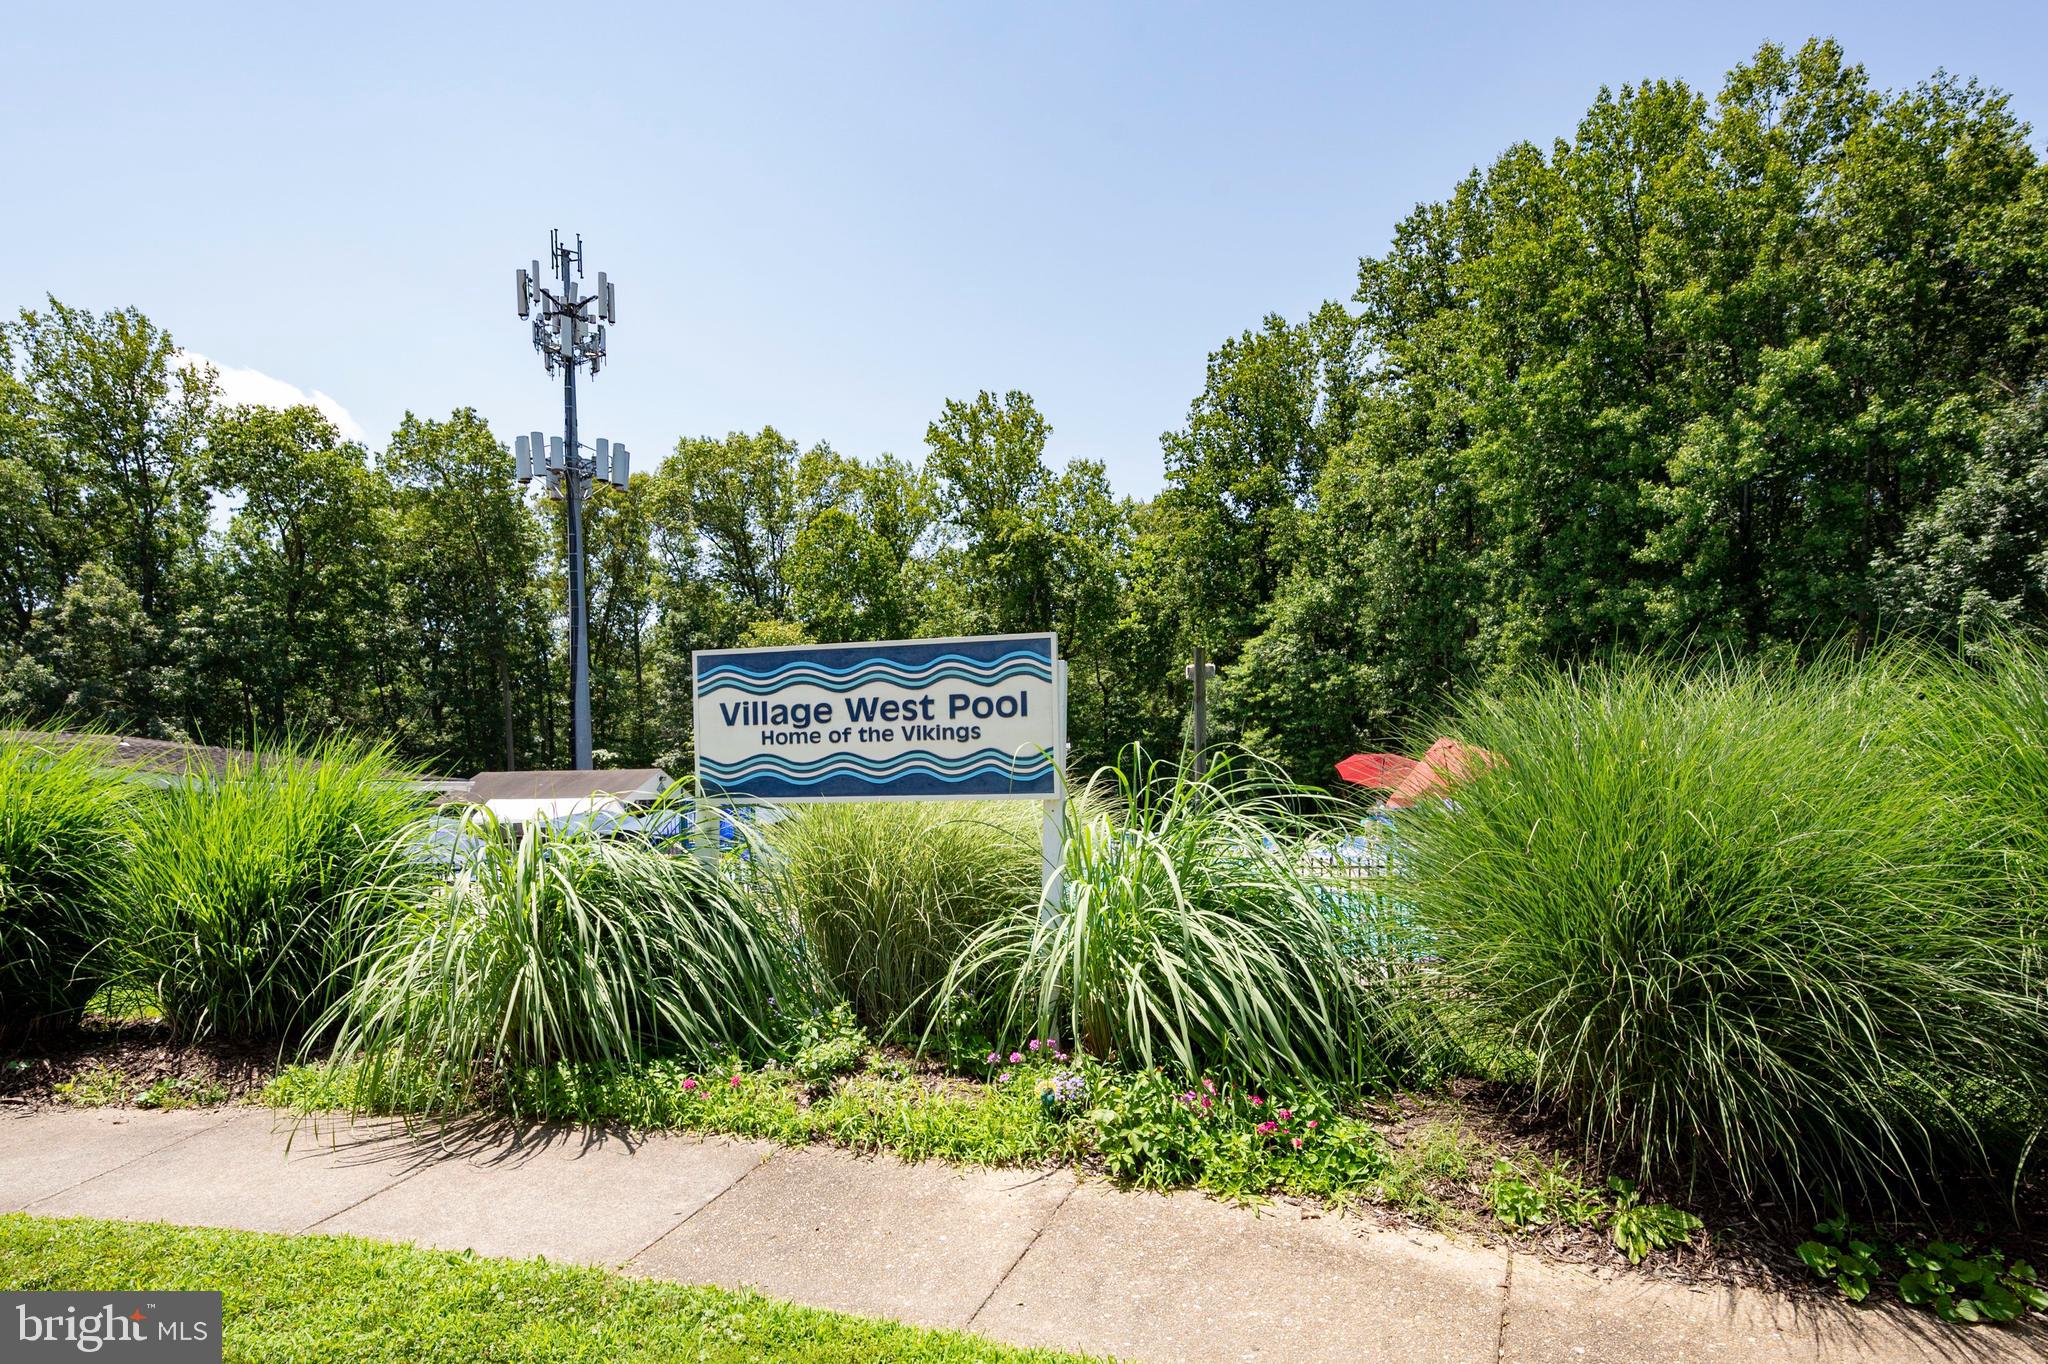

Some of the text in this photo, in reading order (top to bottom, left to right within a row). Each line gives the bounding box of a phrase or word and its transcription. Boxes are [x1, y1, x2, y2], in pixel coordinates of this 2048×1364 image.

[719, 690, 1028, 729] Village West Pool
[761, 723, 981, 746] Home of the Vikings
